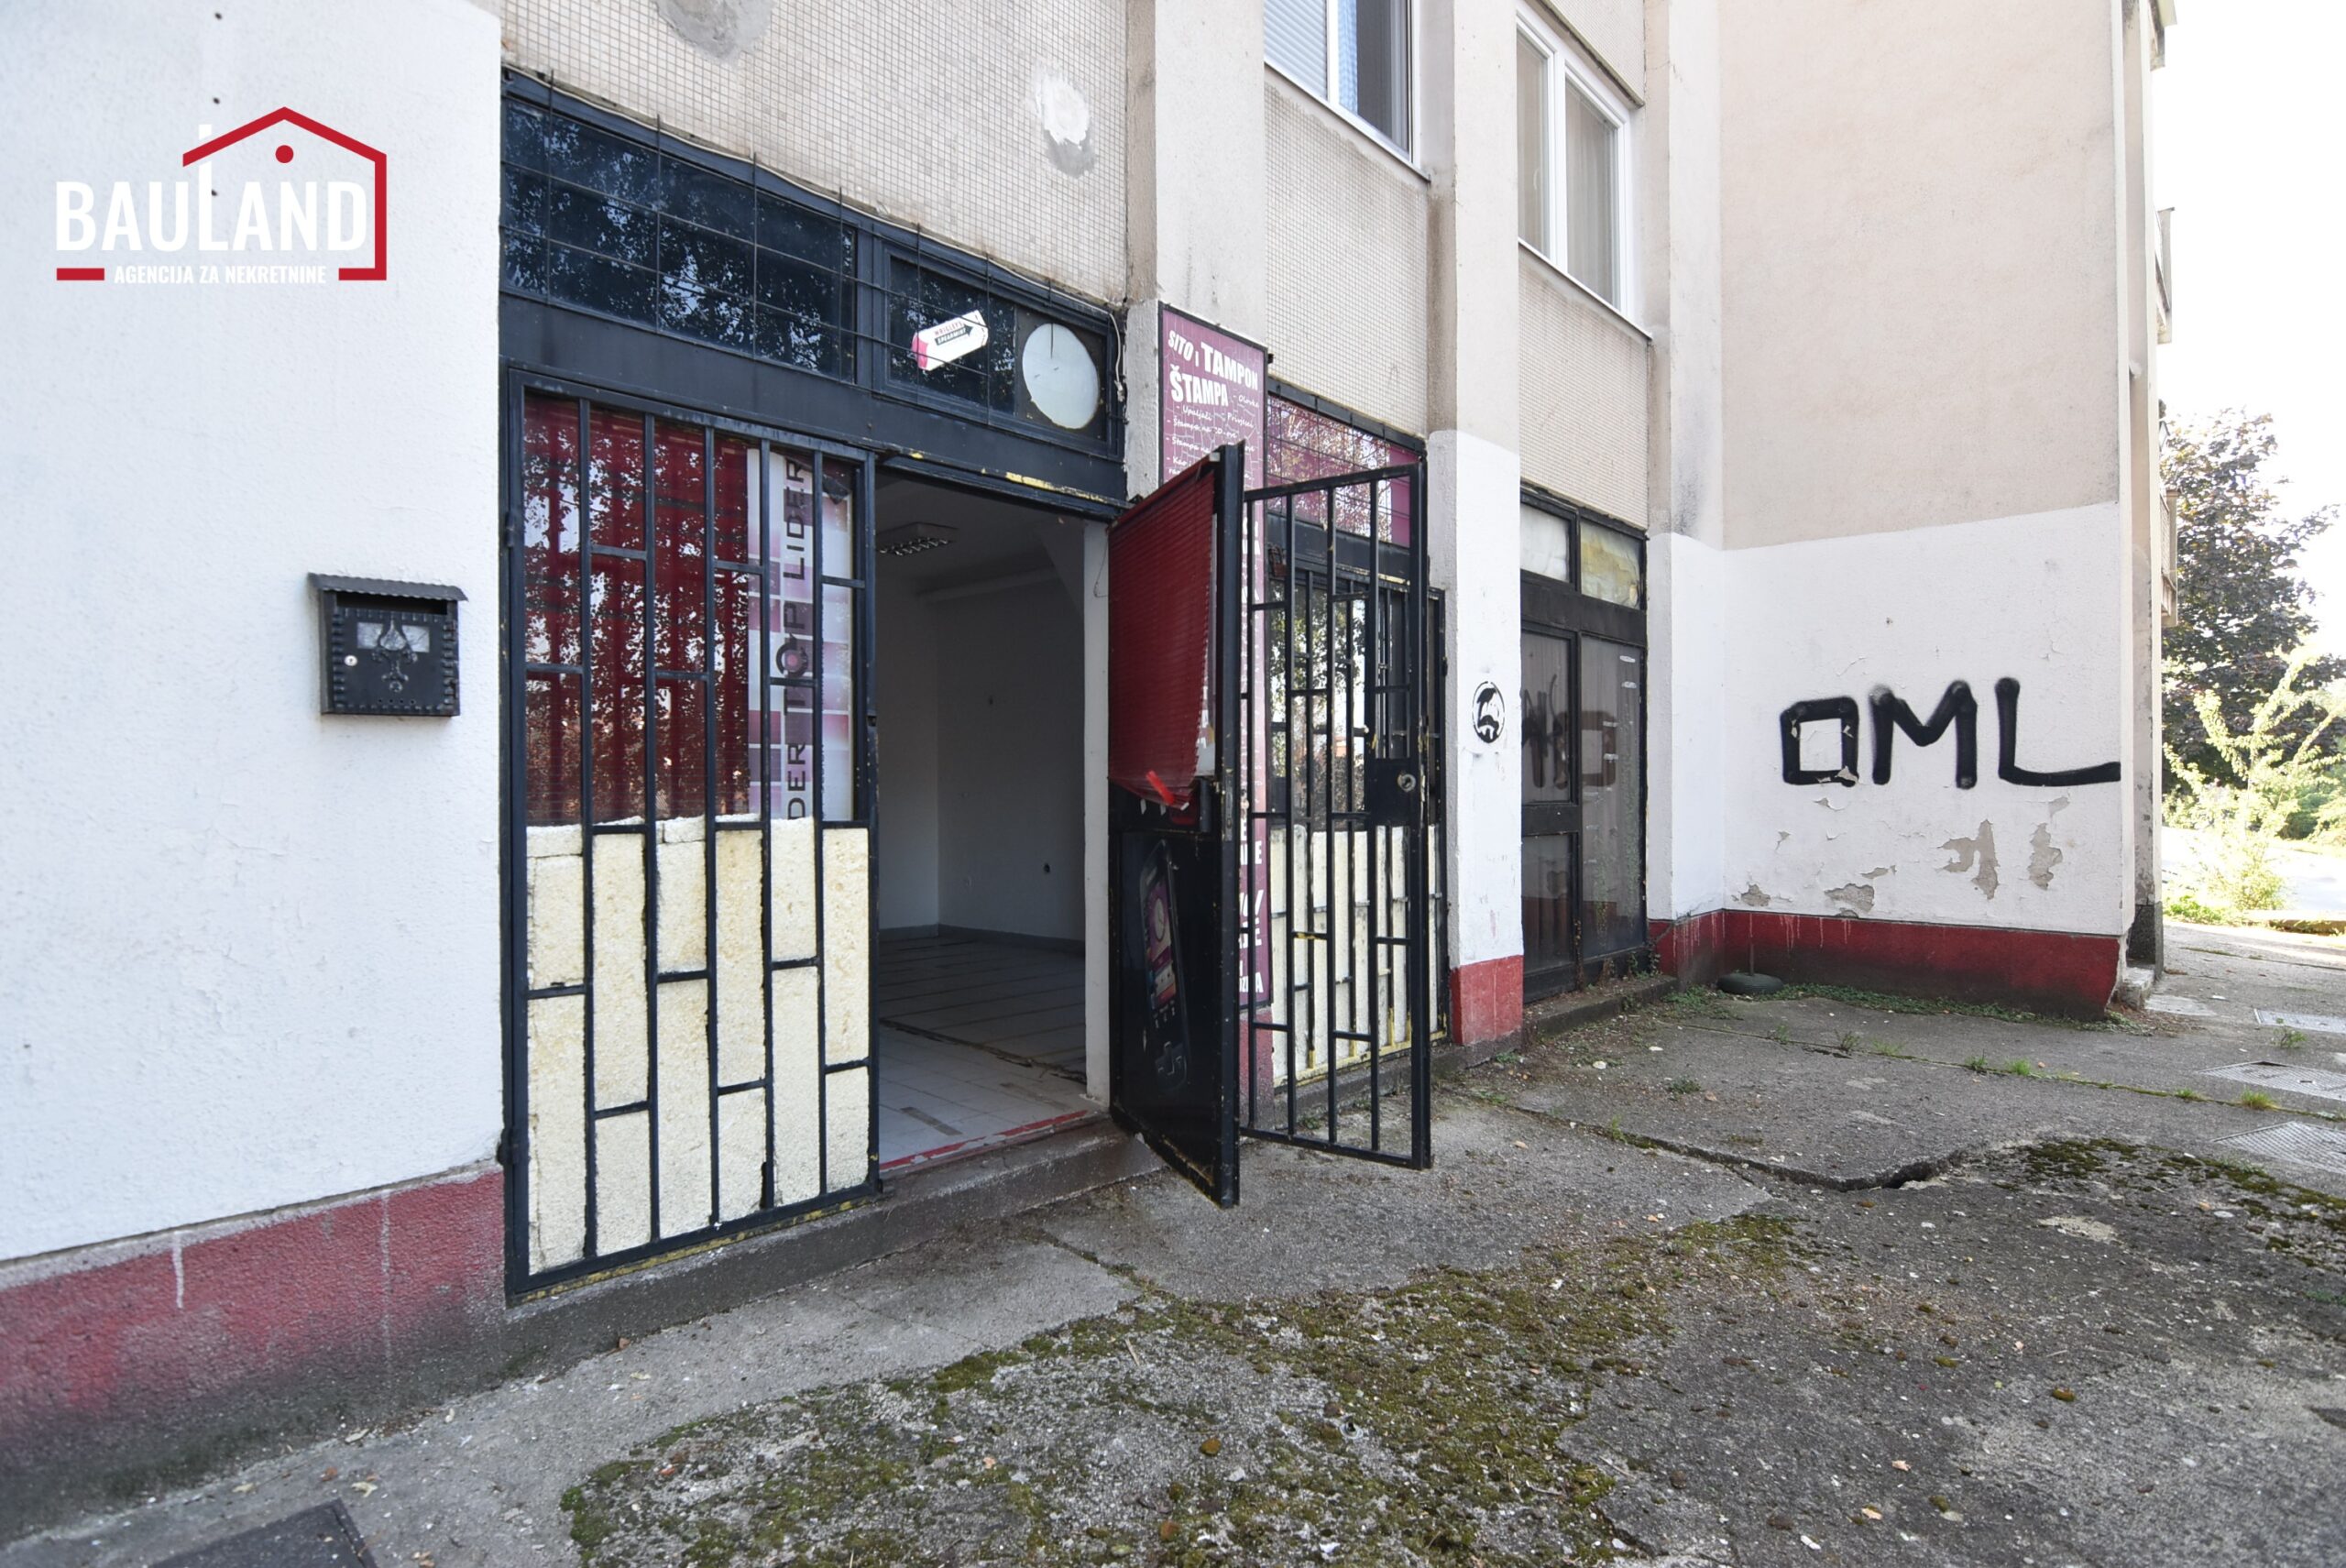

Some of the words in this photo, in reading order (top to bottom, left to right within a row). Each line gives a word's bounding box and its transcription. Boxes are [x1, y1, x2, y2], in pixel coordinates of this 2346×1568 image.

[1168, 330, 1194, 361] SITO
[1200, 341, 1258, 390] TAMPON
[1169, 364, 1229, 407] ŠTAMPA
[784, 456, 805, 580] LIDER
[1780, 675, 2121, 789] OML
